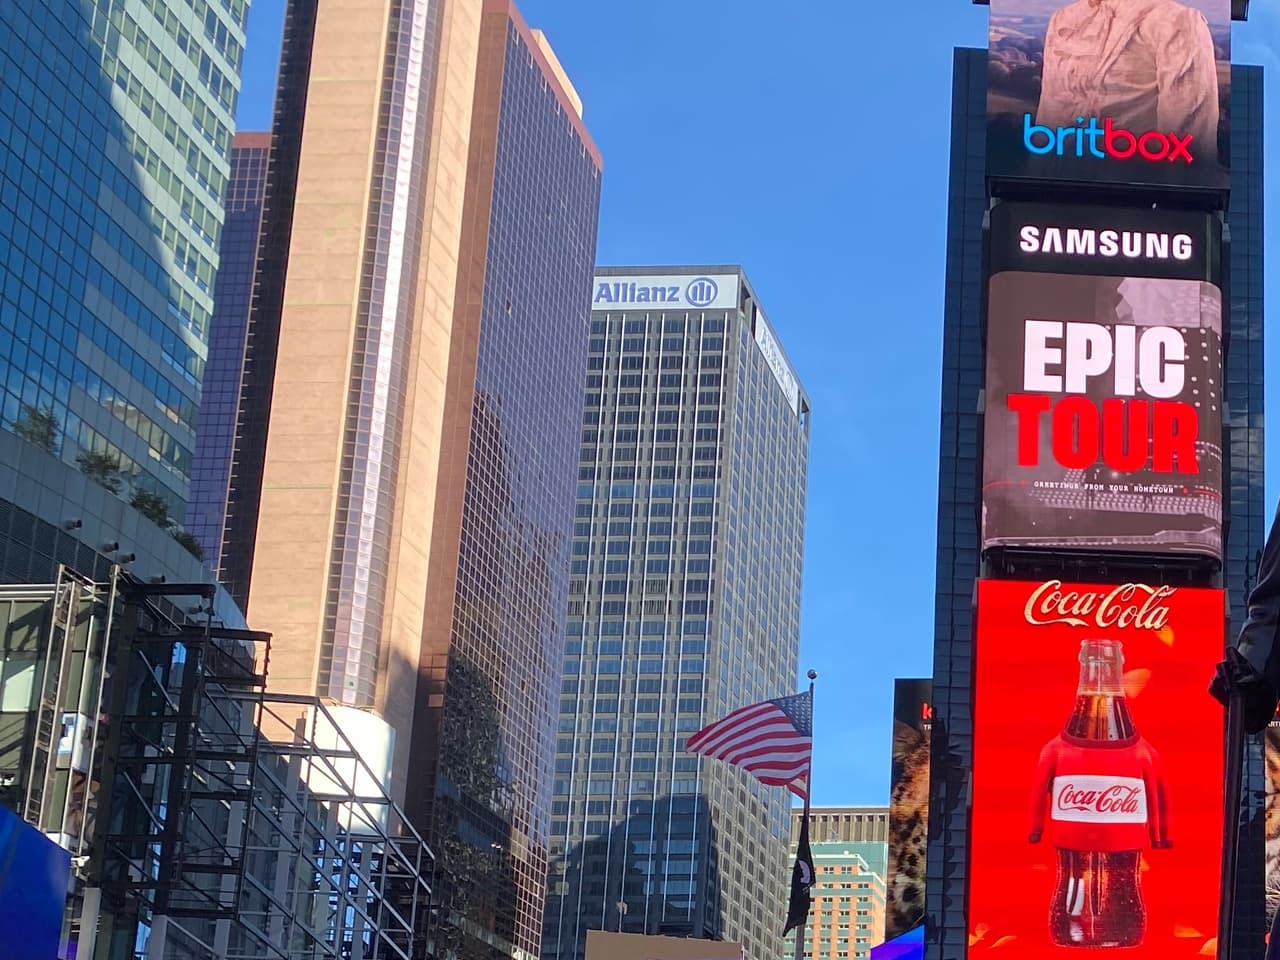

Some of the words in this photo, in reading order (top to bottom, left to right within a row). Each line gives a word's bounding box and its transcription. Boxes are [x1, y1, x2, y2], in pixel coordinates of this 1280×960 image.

[1023, 112, 1194, 164] britbox
[1019, 225, 1193, 261] SAMSUNG
[594, 282, 681, 303] Allianz
[1023, 319, 1185, 399] EPIC
[1006, 393, 1200, 475] TOUR
[1084, 483, 1104, 491] FROM
[1109, 484, 1129, 492] YOUR
[1133, 485, 1174, 494] HOMETOWN
